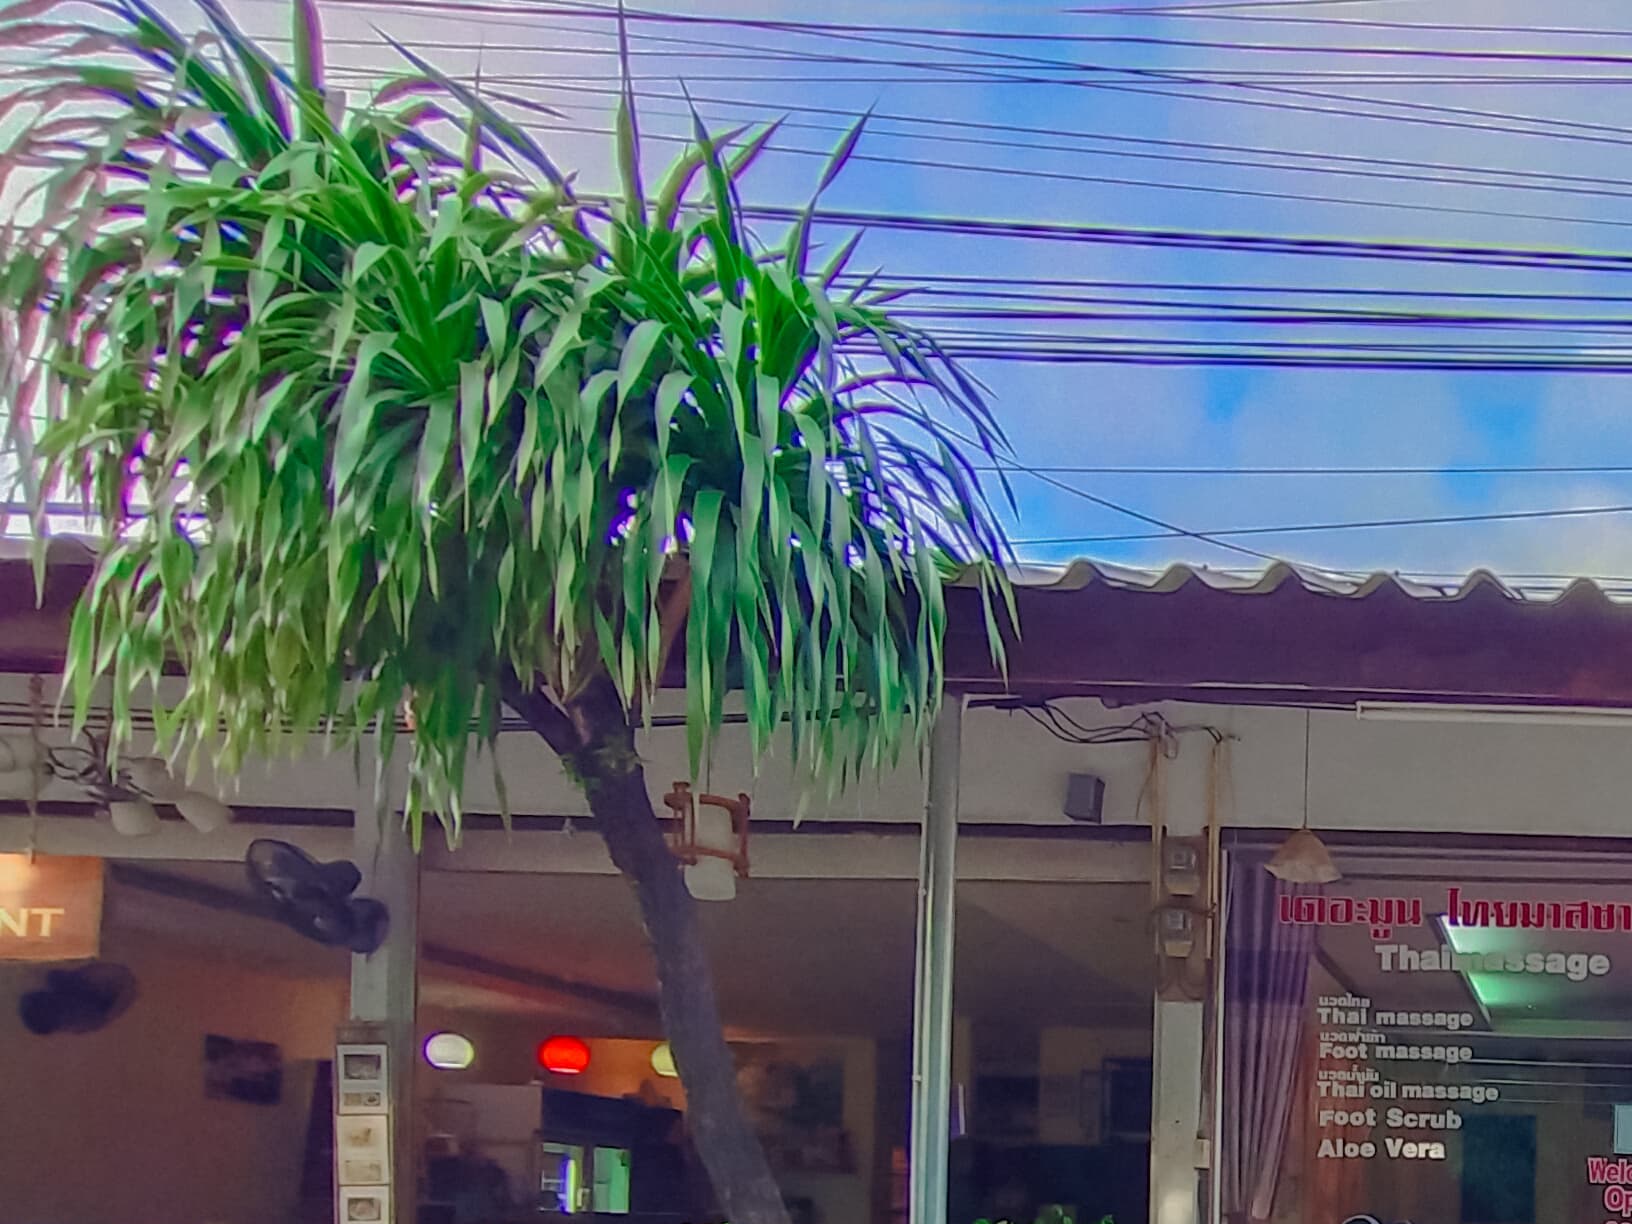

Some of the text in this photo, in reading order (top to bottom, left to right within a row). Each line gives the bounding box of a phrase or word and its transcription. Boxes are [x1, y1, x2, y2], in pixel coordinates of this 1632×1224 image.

[1375, 944, 1611, 980] Thai massage
[1317, 1007, 1474, 1030] Thai massage
[1319, 1042, 1473, 1064] Foot massage
[1317, 1079, 1500, 1104] Thai oil massage
[1319, 1107, 1463, 1129] Foot Scrub
[1317, 1137, 1446, 1159] Aloe Vera
